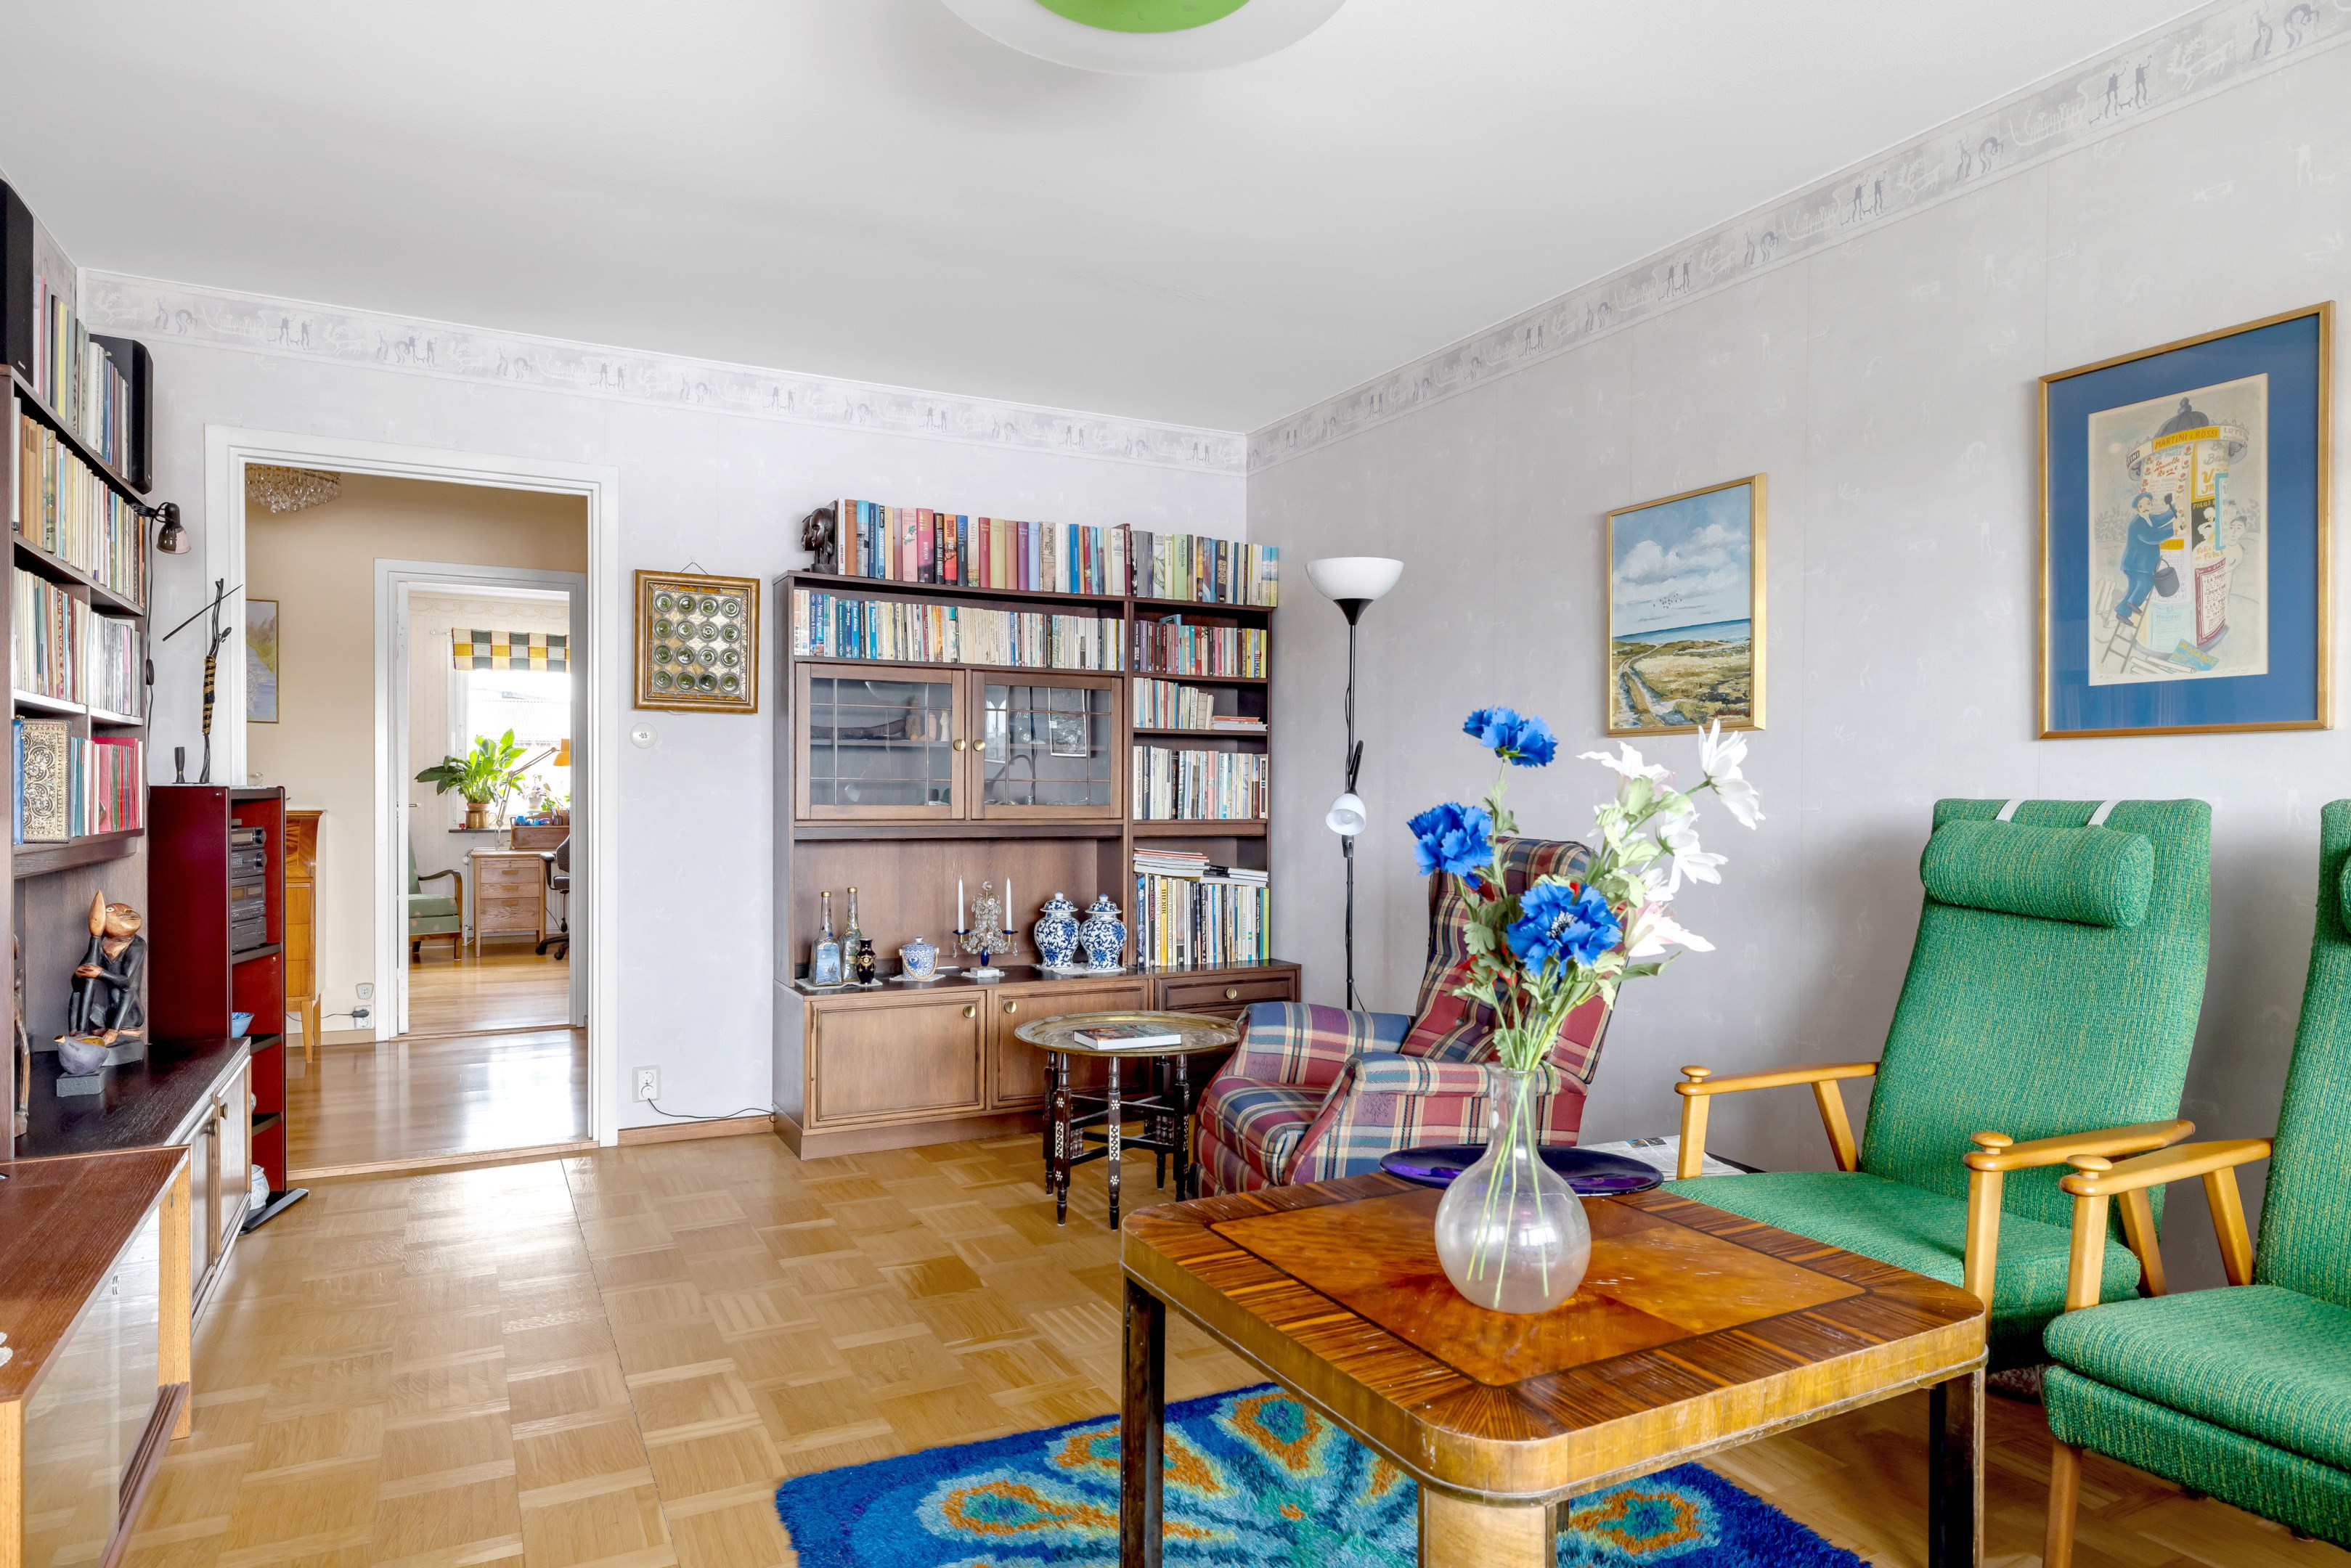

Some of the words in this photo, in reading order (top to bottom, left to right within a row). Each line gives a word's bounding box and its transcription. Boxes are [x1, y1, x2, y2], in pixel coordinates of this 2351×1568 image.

[2155, 433, 2187, 449] MARTINI
[2196, 430, 2217, 438] ROSSI
[2193, 501, 2211, 510] FOLIES
[1218, 560, 1227, 584] SEGU
